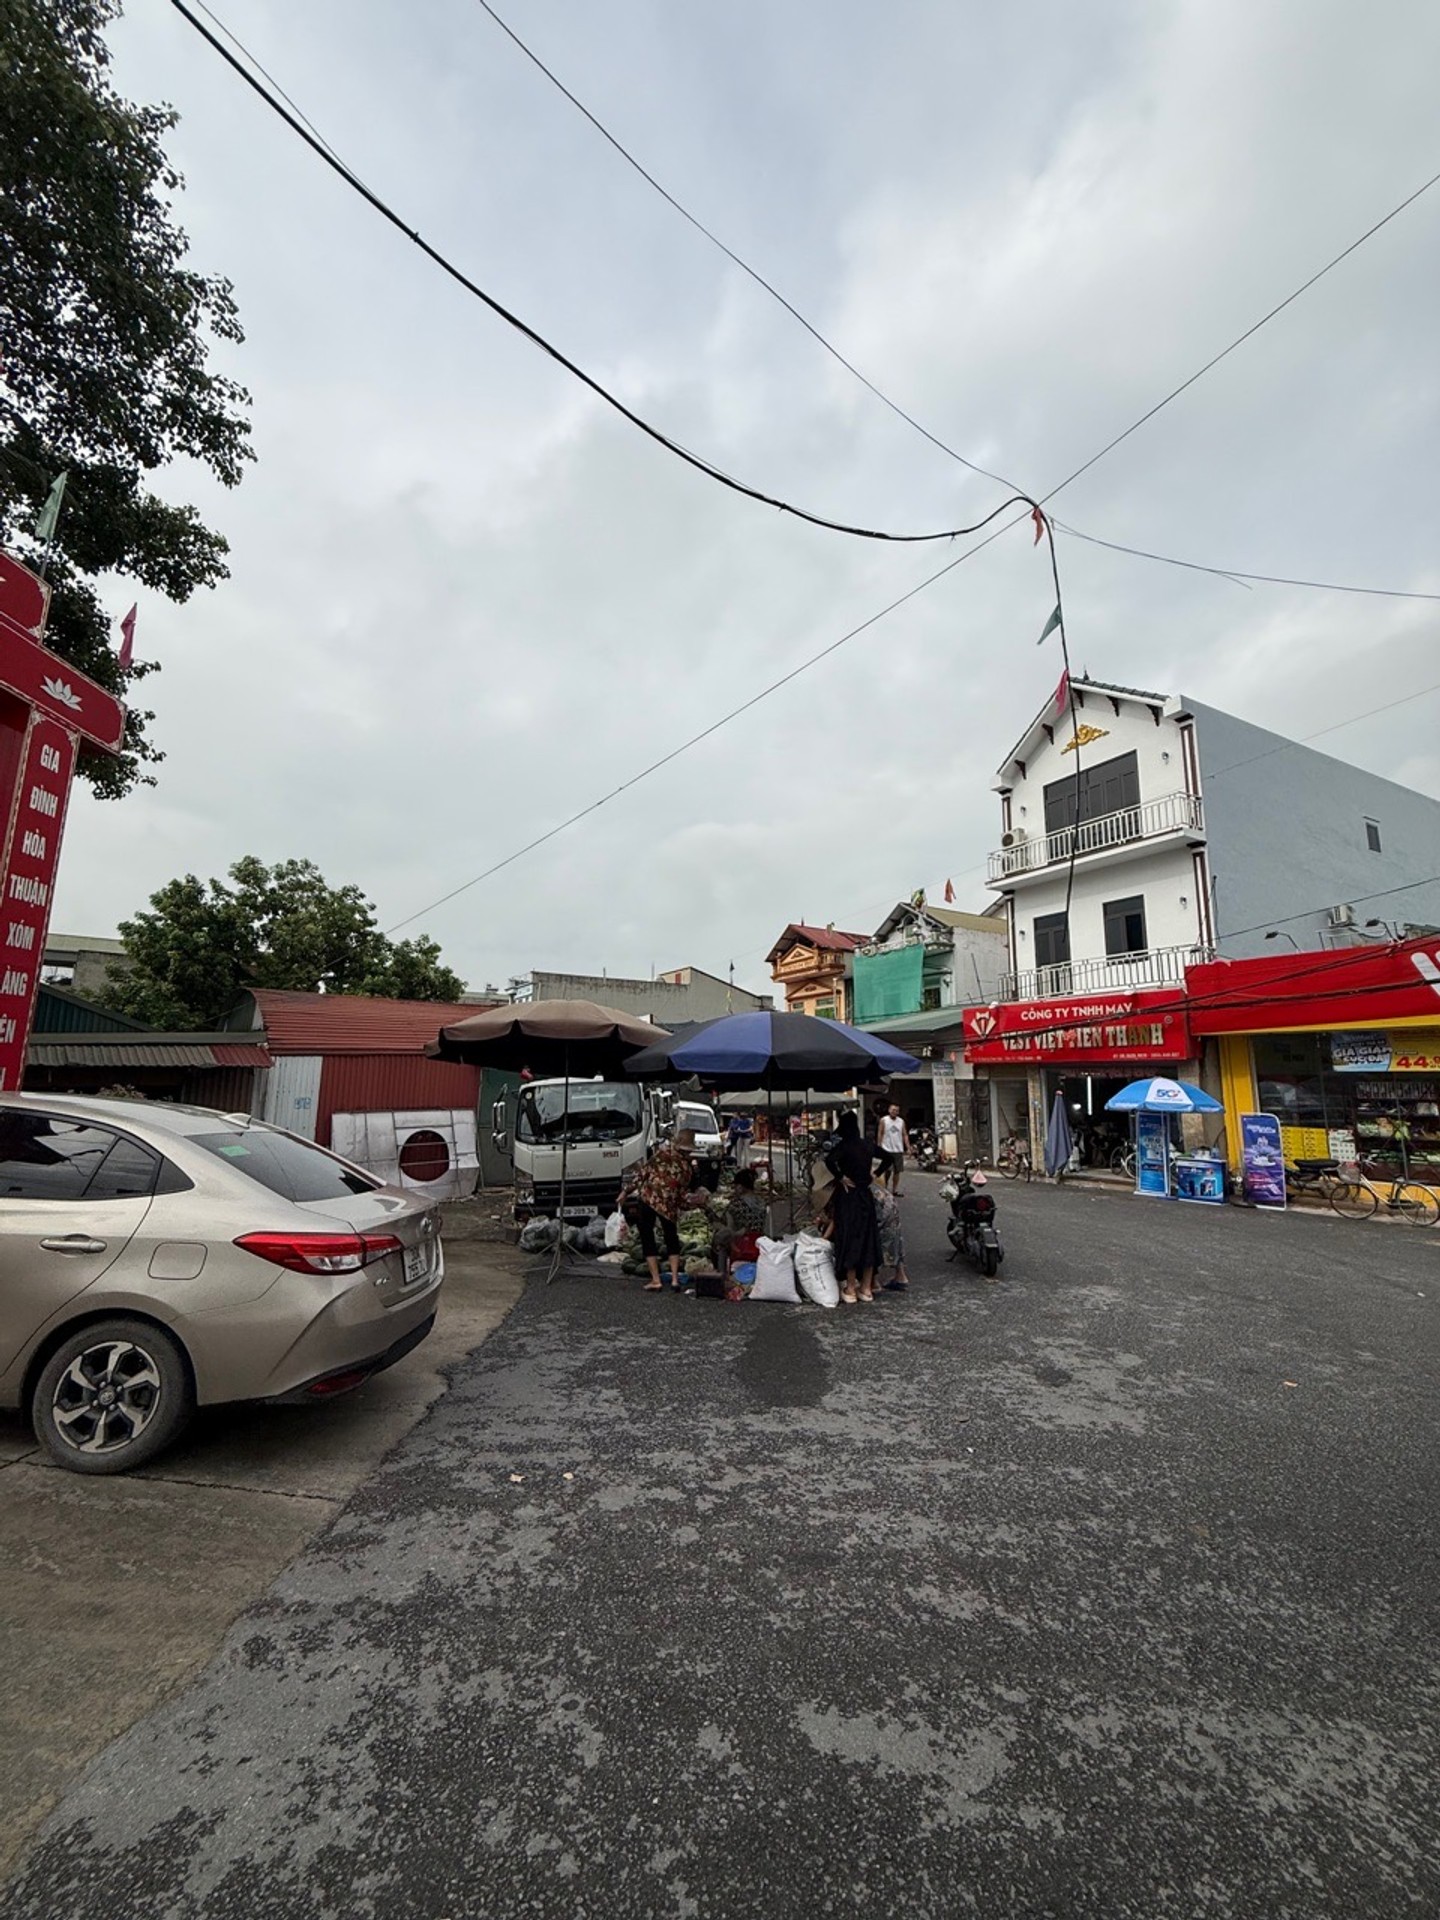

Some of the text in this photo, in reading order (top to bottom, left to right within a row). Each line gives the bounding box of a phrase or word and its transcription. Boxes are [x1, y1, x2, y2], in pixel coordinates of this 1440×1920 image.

[40, 744, 60, 774] GIA
[29, 785, 59, 819] ĐÌNH
[22, 828, 47, 860] HÒA
[10, 873, 48, 908] THUẬN
[6, 919, 35, 950] XÓM
[0, 965, 29, 997] ÀNG
[1021, 1002, 1133, 1020] CÔNG TY TNHH MAY
[0, 1013, 17, 1043] ÊN
[1001, 1031, 1031, 1051] VEST
